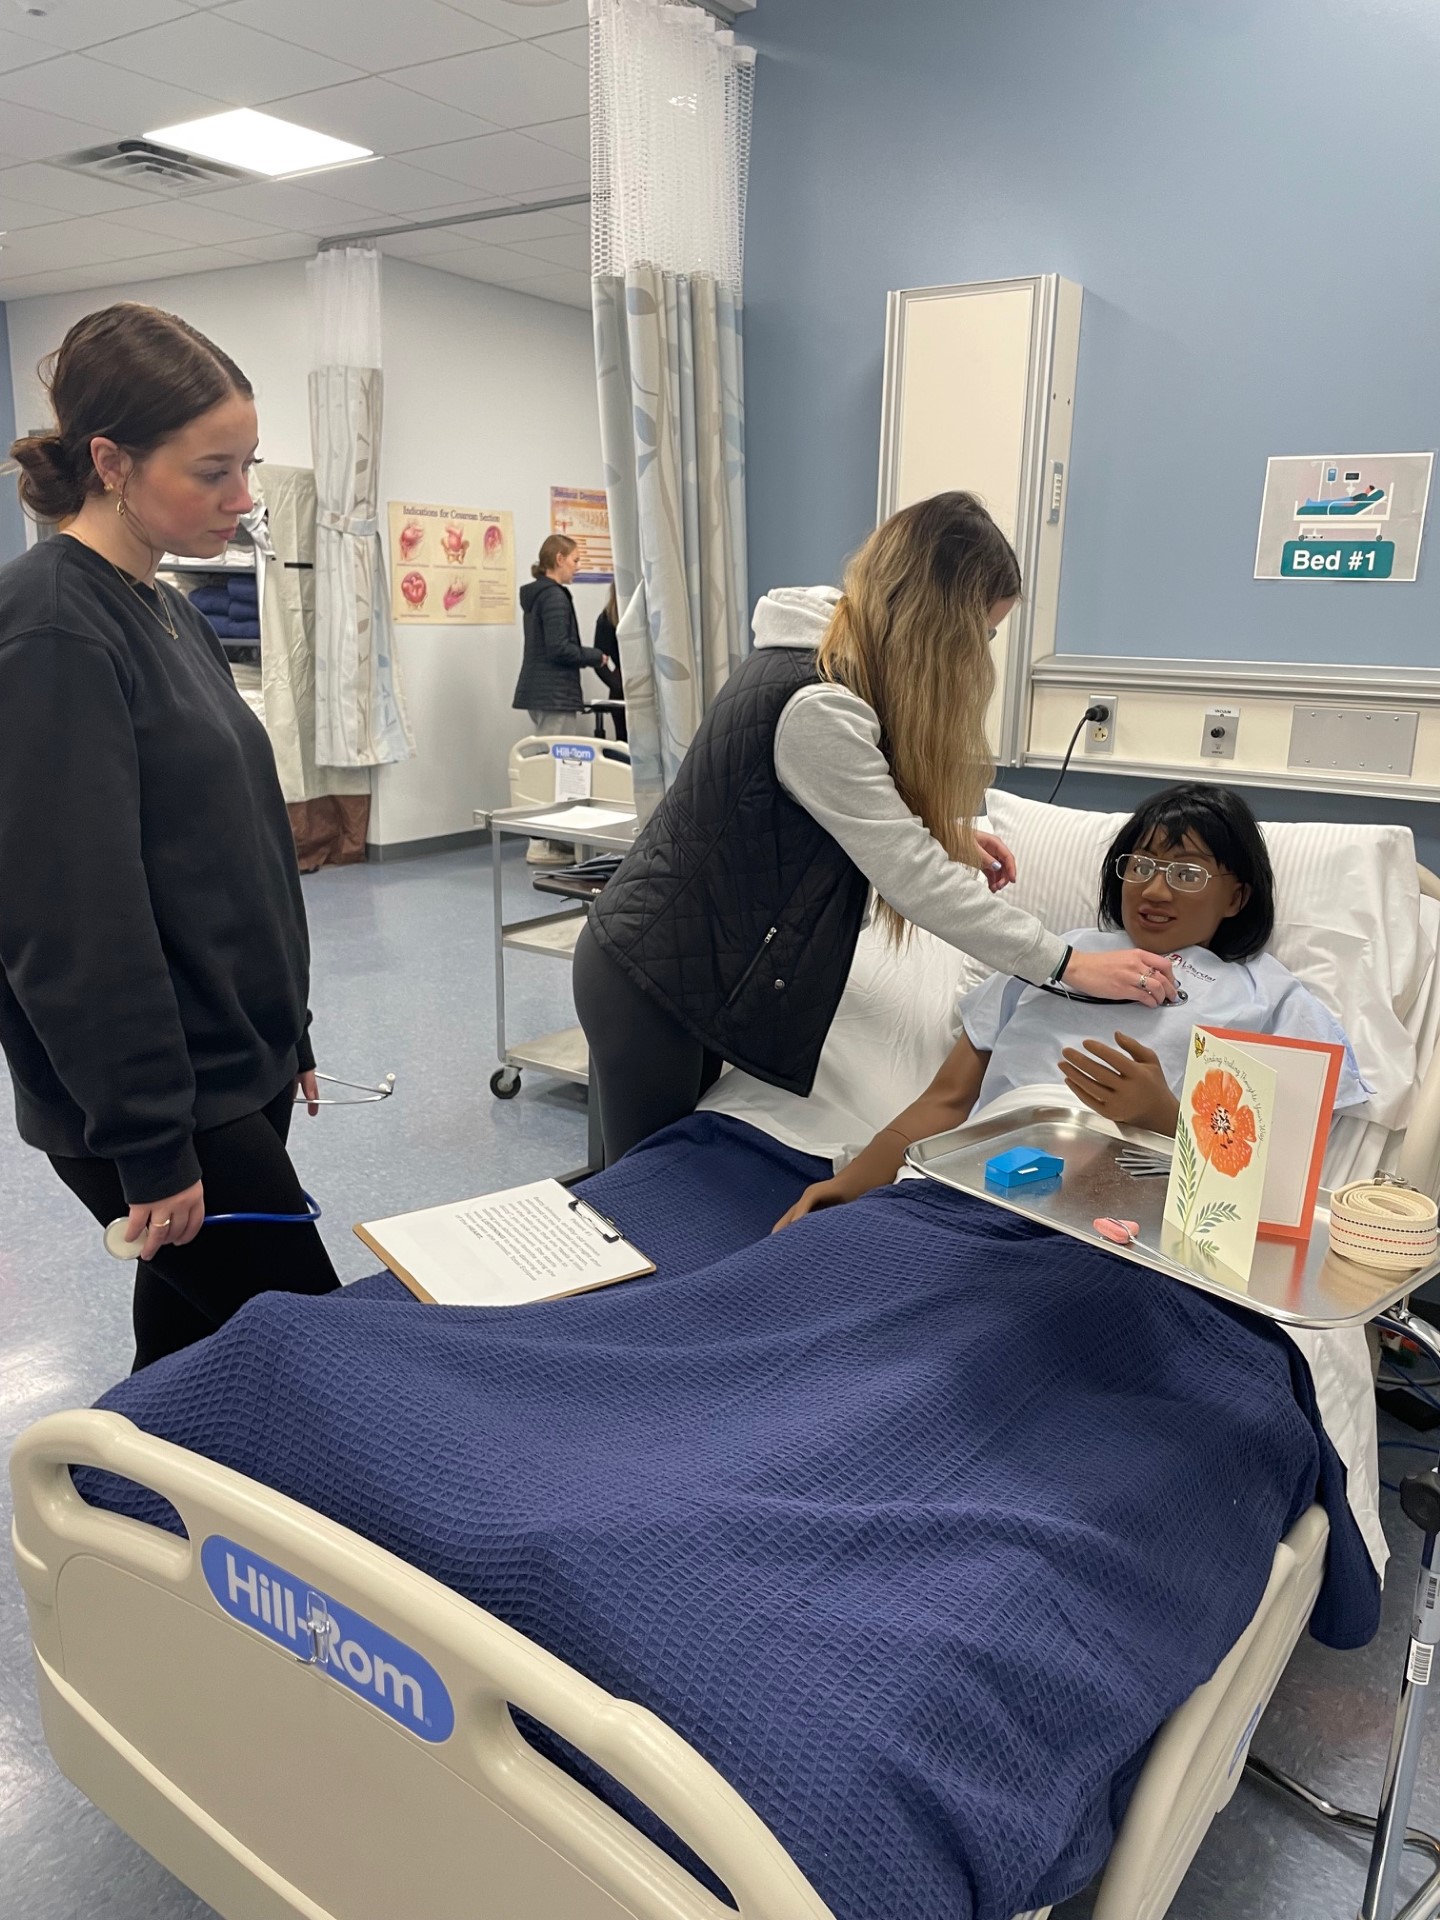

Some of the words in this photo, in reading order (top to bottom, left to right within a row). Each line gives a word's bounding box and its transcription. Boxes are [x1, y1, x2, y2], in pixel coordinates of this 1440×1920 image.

[439, 508, 450, 518] for
[1292, 549, 1341, 570] Bed
[1347, 550, 1376, 571] #1
